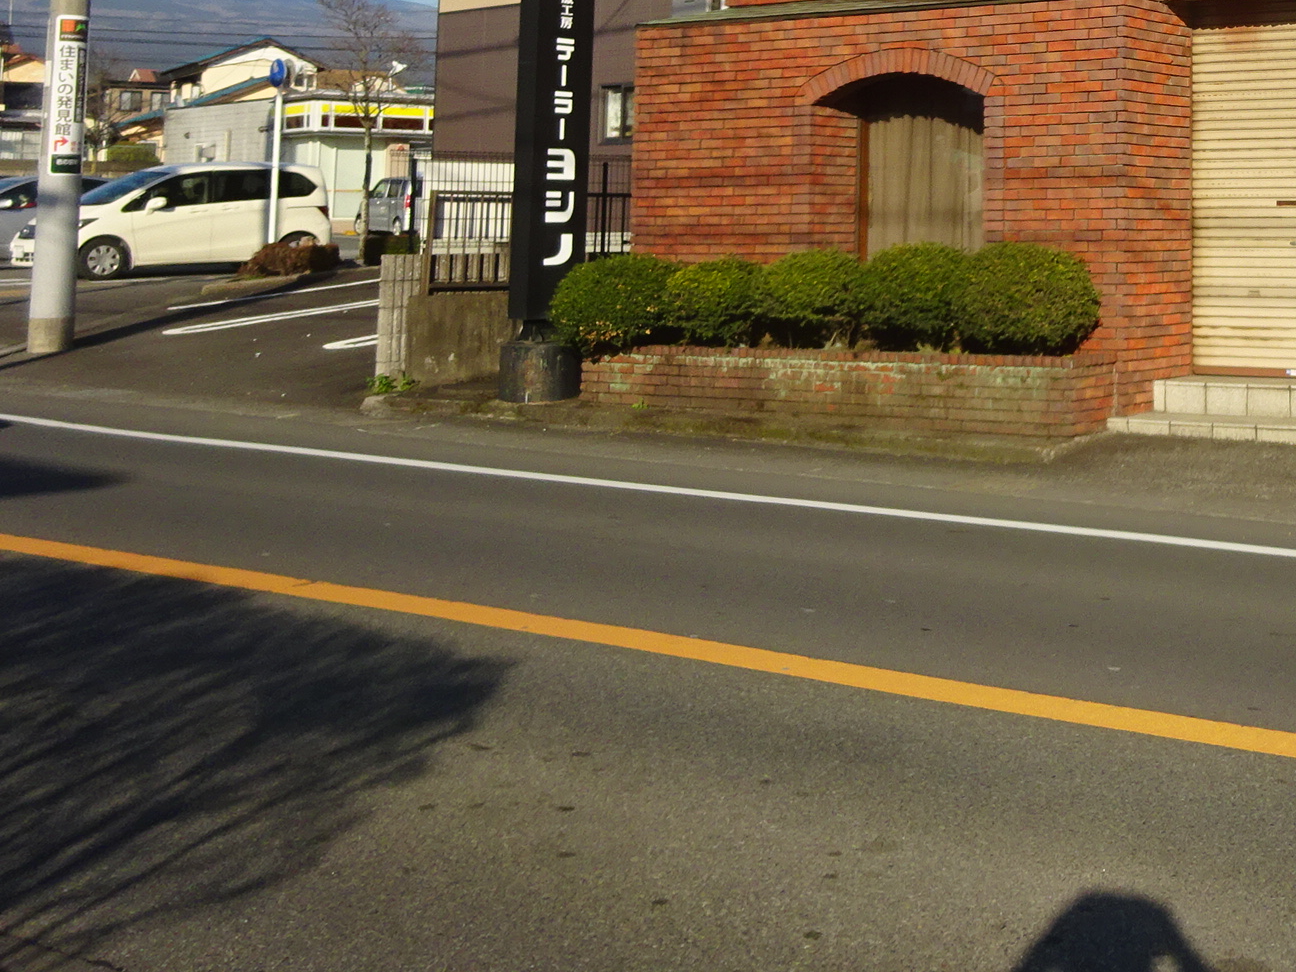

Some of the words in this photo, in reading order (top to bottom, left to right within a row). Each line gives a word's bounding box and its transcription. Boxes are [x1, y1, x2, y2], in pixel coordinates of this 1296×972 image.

[54, 44, 76, 136] 住まいの発見館
[543, 38, 576, 266] テーラーヨシノ
